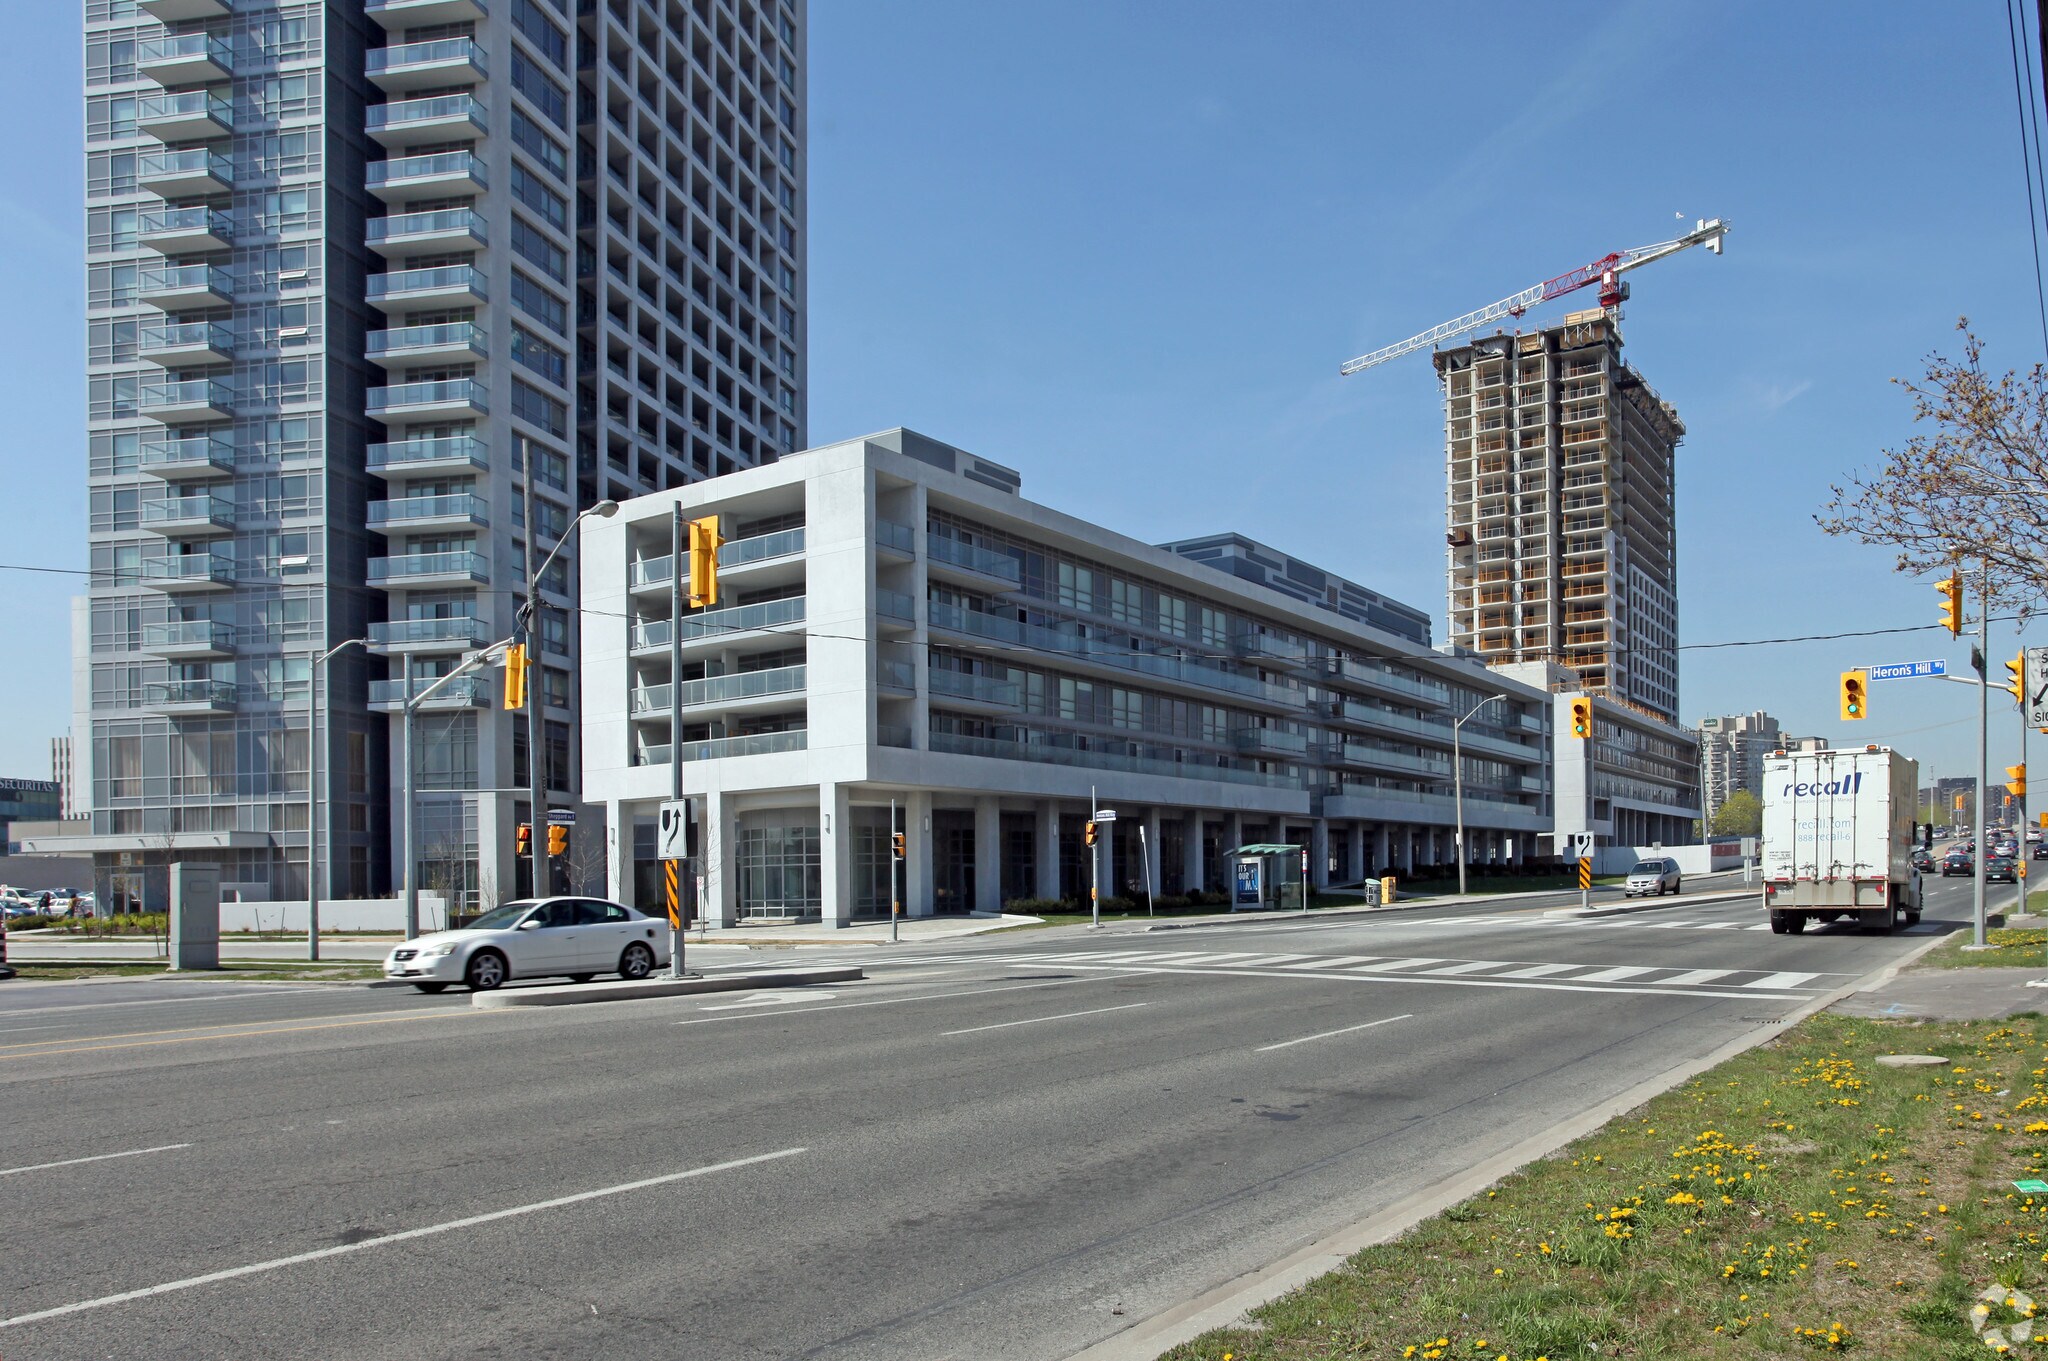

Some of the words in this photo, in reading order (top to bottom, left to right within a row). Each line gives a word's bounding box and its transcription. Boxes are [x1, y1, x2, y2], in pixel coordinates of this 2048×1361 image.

[1873, 665, 1912, 678] Heron's
[1915, 663, 1932, 674] Hill
[0, 779, 53, 792] SECURITAS
[1783, 772, 1862, 797] recall
[1798, 819, 1851, 830] recll.om
[1798, 831, 1851, 842] 888-ecall-6
